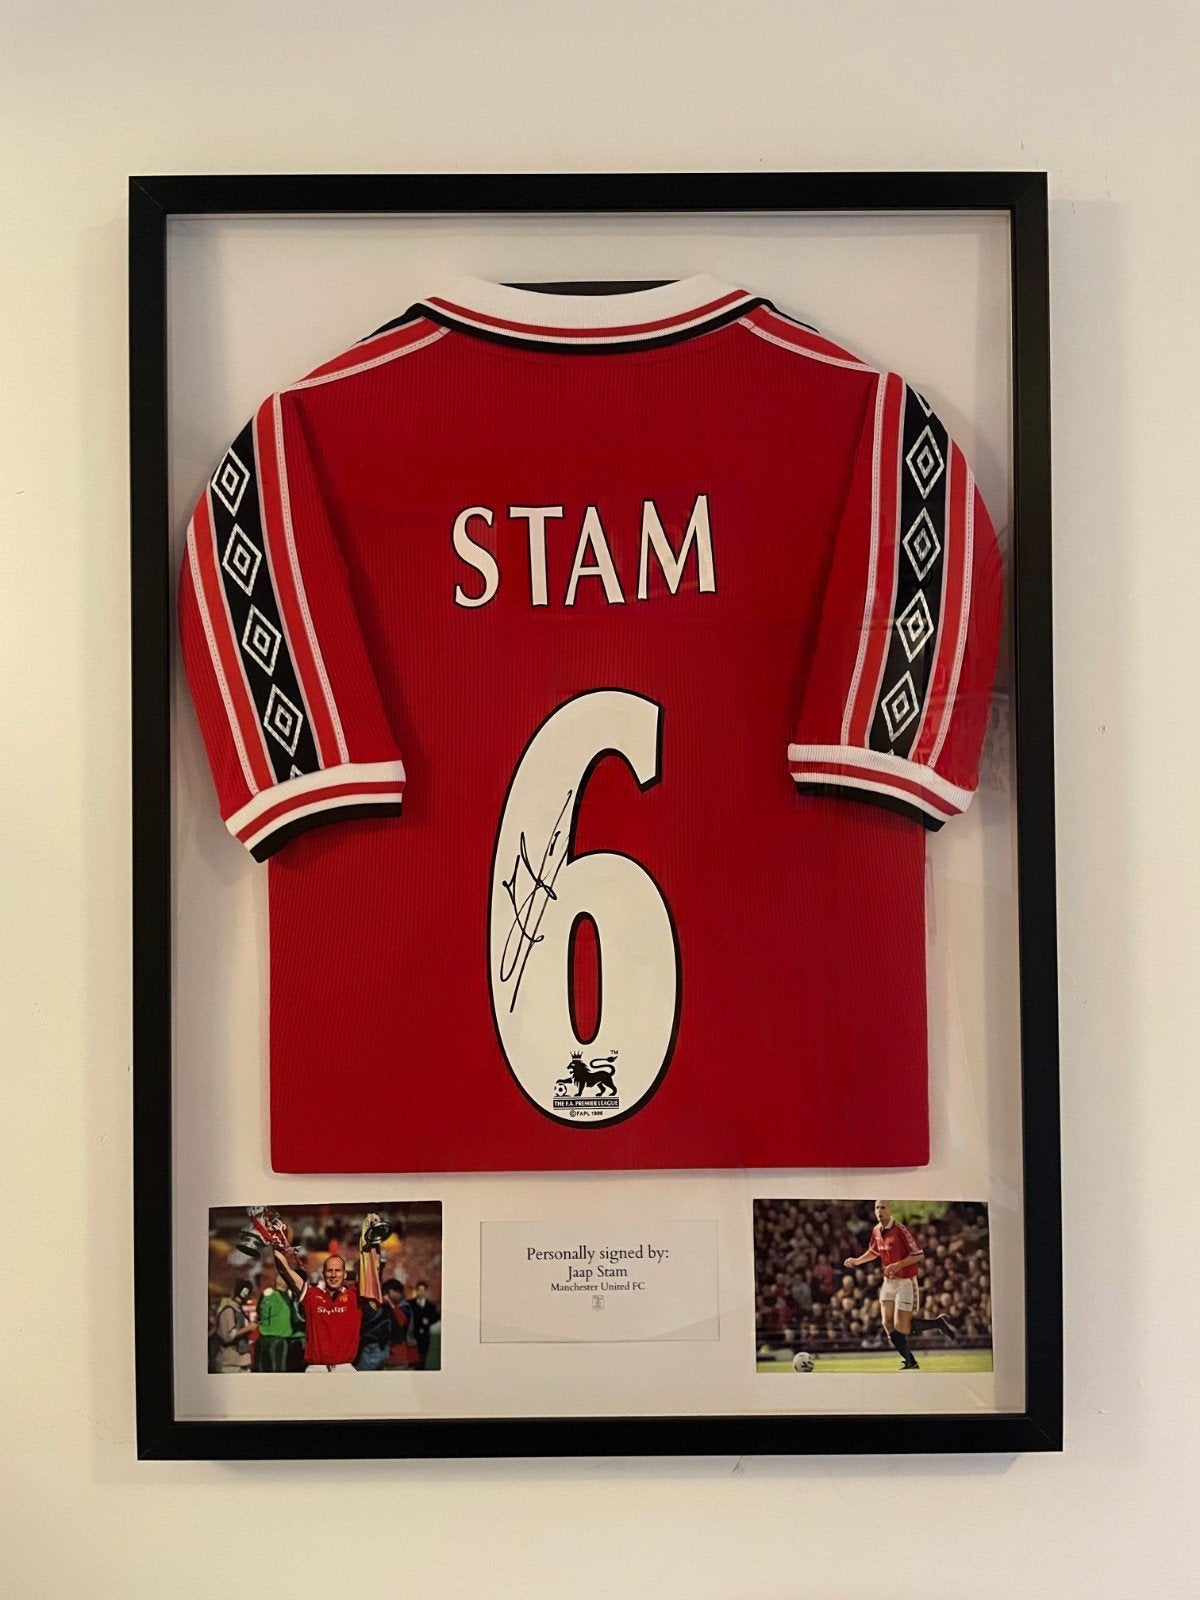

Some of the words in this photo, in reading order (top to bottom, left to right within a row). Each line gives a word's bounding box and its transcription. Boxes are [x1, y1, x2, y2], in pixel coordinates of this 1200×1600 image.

[452, 494, 716, 608] STAM
[487, 687, 682, 1129] 6
[526, 1244, 595, 1264] Personally
[599, 1244, 643, 1263] signed
[647, 1244, 669, 1264] by:
[566, 1265, 593, 1282] Jaap
[597, 1265, 628, 1278] Stam
[550, 1282, 598, 1292] Manchester
[600, 1282, 630, 1291] United
[632, 1282, 646, 1290] FC
